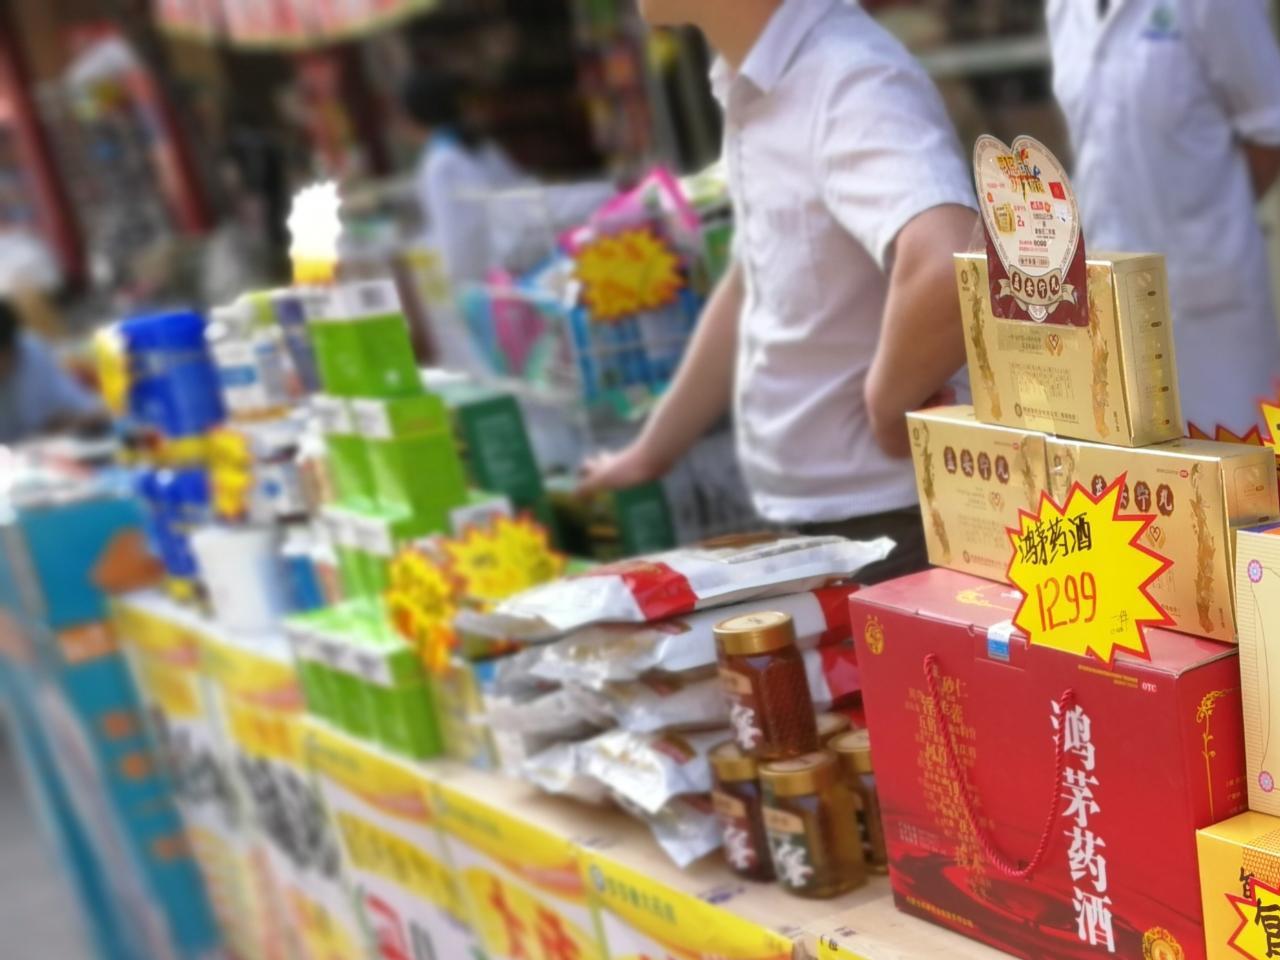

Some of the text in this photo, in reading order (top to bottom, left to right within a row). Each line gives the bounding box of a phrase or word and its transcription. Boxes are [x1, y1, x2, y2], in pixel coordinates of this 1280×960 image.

[1017, 512, 1092, 565] 鸿茅药酒
[1036, 572, 1096, 632] 1299
[1142, 682, 1157, 692] OTC
[1051, 699, 1116, 953] 鸿茅药酒
